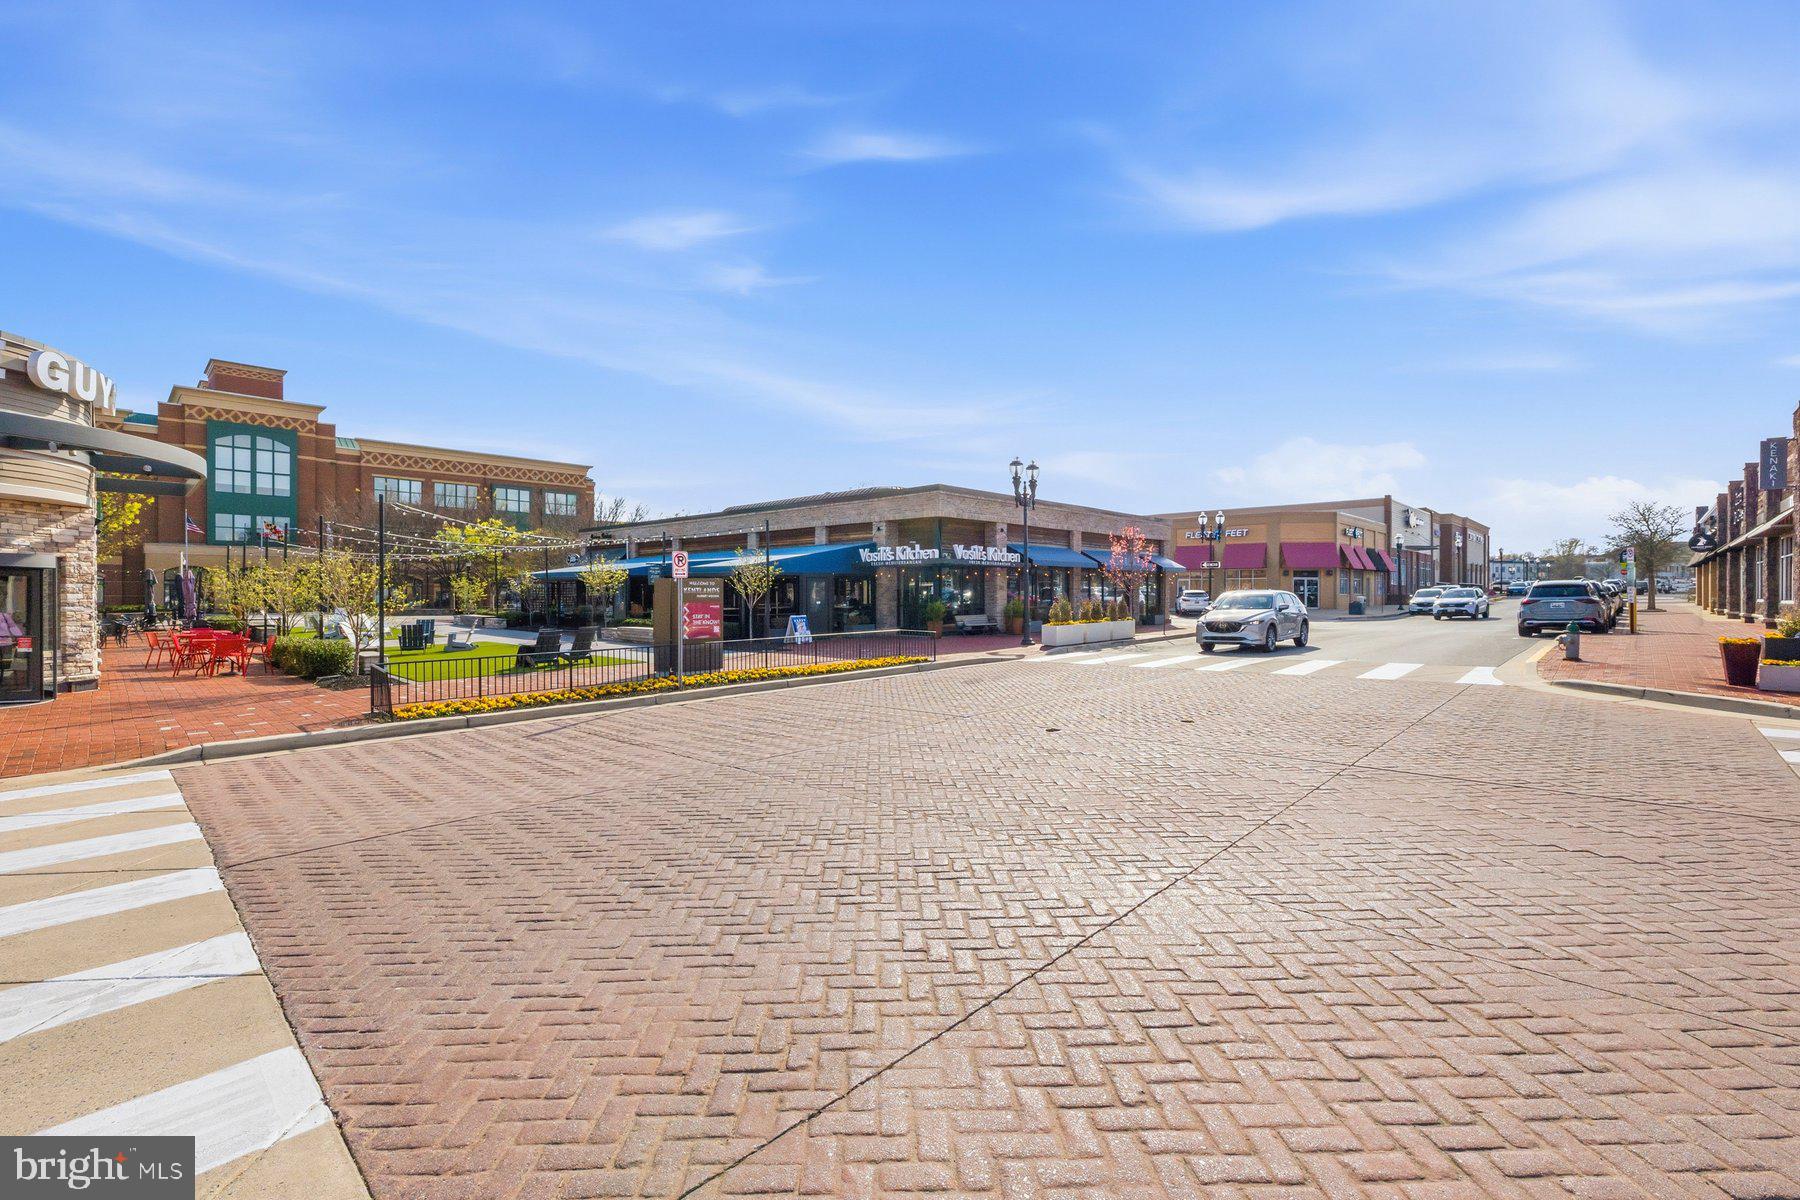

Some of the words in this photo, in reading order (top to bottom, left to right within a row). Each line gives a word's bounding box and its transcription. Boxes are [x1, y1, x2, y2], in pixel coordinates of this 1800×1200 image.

[27, 351, 117, 417] GUY
[1769, 442, 1778, 486] KENAKI
[1225, 528, 1248, 537] FEET
[896, 544, 939, 560] Kitchen
[987, 547, 1020, 562] Kitchen
